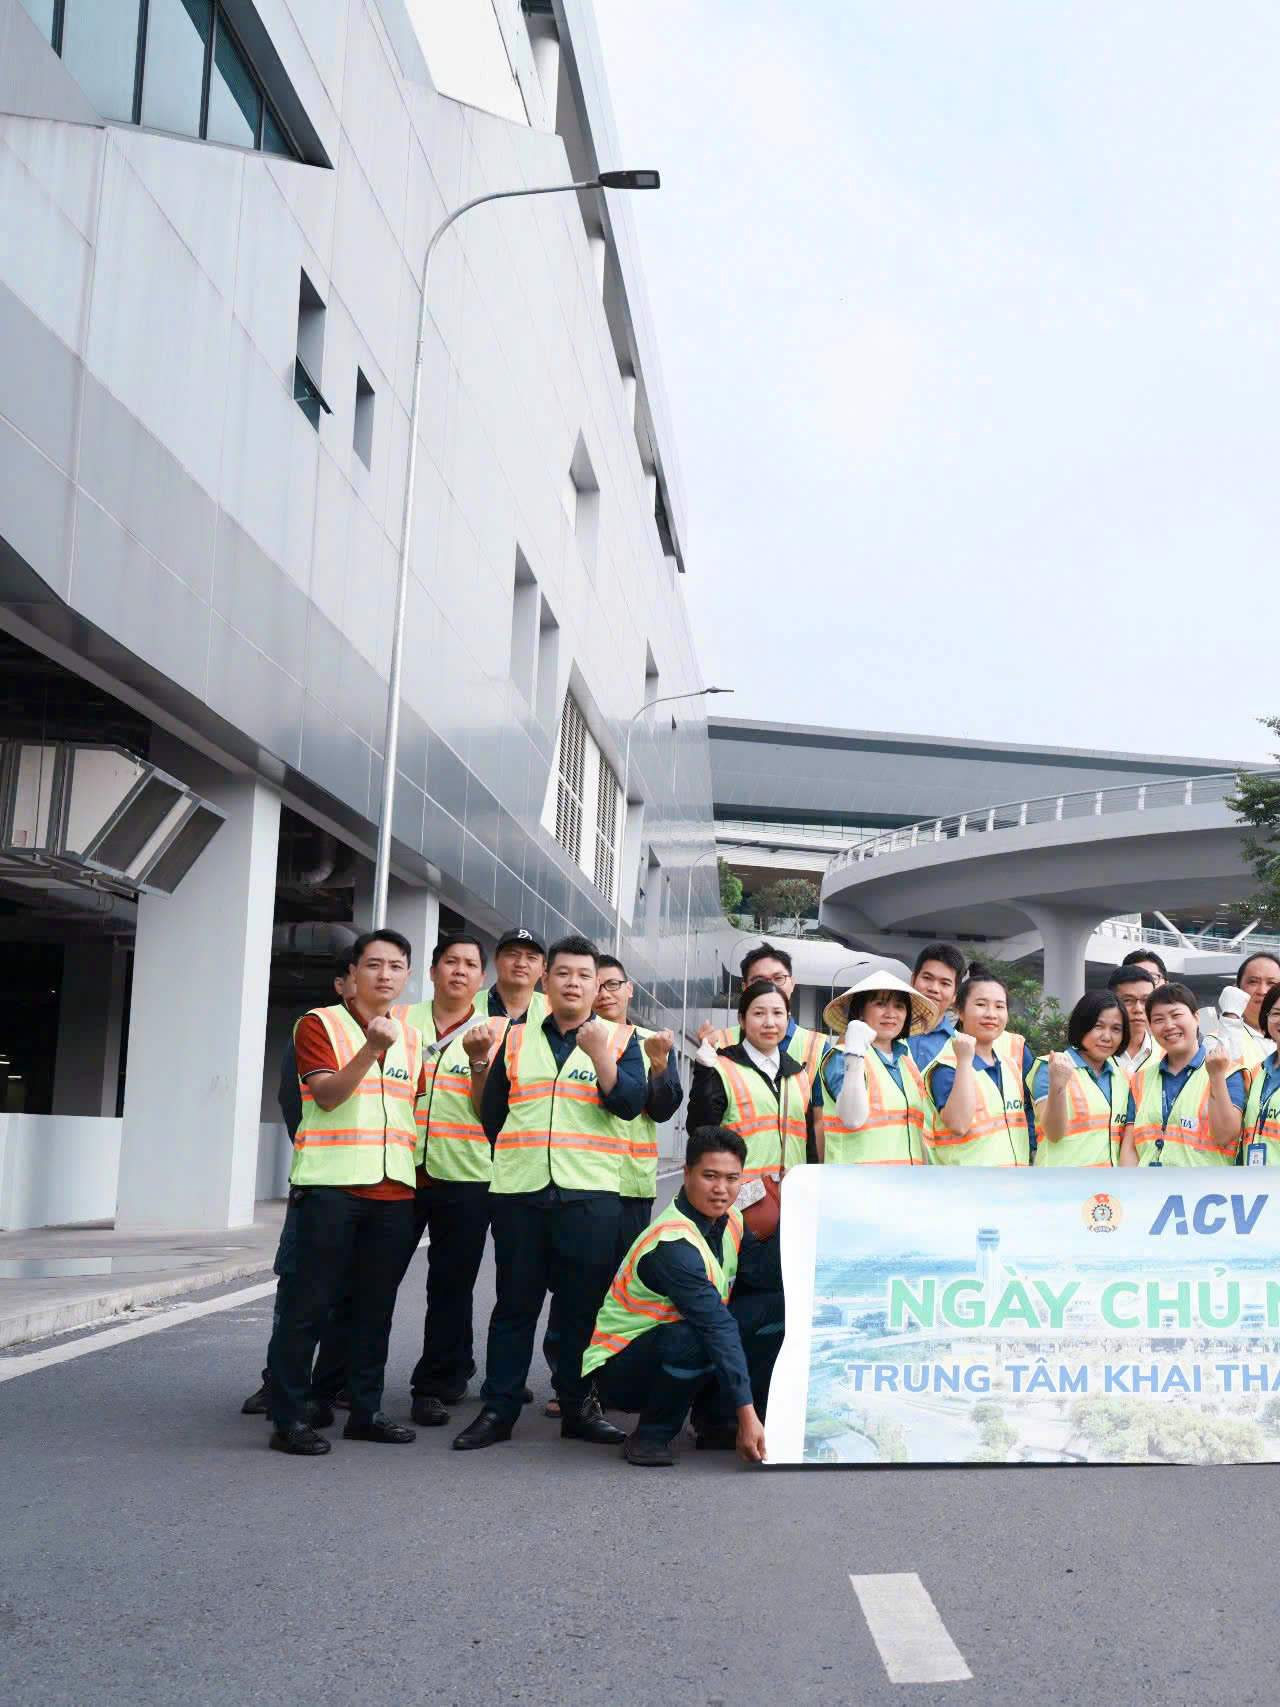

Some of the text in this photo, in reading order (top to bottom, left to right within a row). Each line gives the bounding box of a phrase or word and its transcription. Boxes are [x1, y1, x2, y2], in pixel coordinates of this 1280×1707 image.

[449, 1064, 470, 1074] AC
[1114, 1113, 1128, 1124] AC
[1148, 1193, 1269, 1236] ACV
[889, 1264, 1081, 1329] NGÀY
[1100, 1266, 1242, 1329] CHỦ
[847, 1363, 991, 1393] TRUNG
[1004, 1357, 1088, 1393] TÂM
[1104, 1364, 1202, 1393] KHAI
